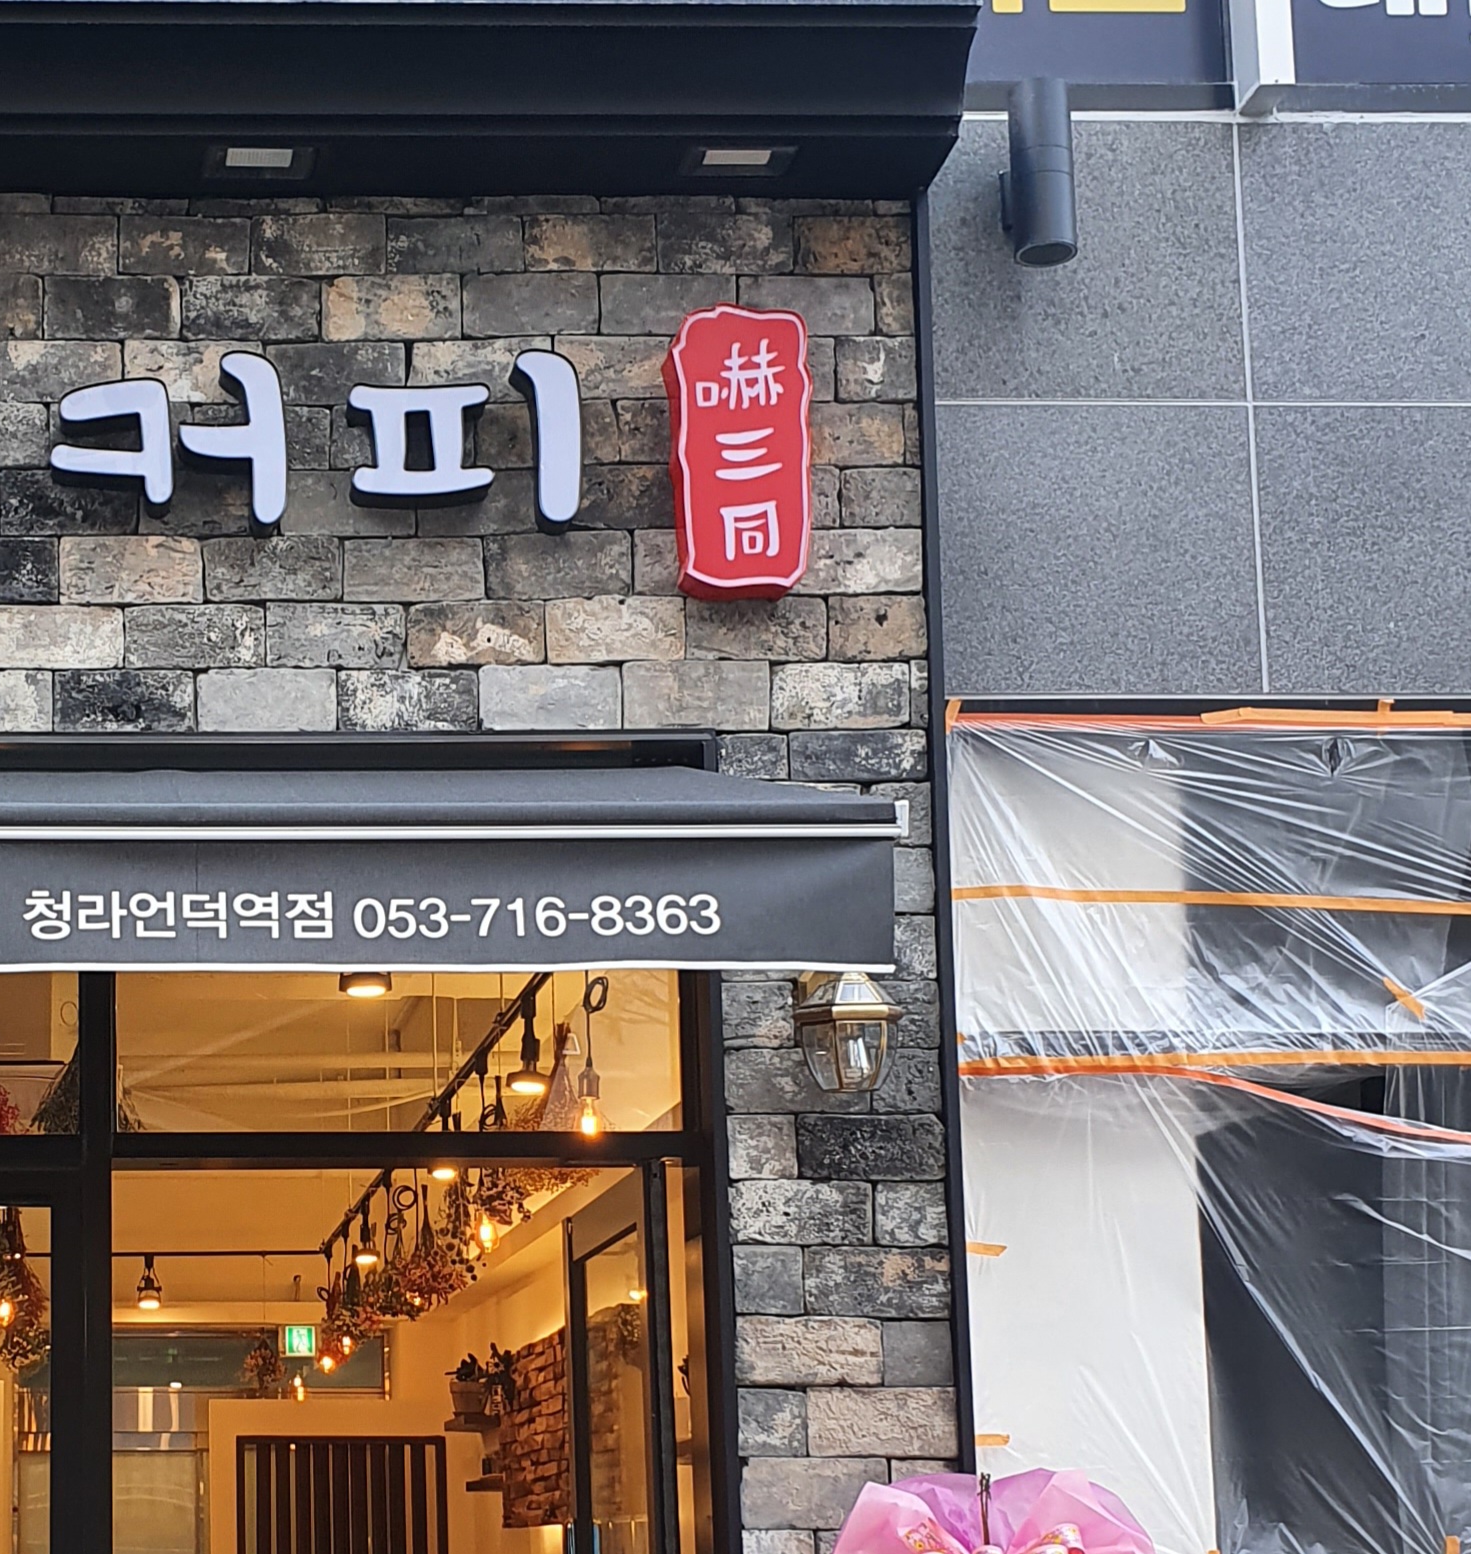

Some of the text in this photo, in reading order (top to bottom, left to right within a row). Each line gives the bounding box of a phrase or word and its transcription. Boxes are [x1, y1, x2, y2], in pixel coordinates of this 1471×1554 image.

[51, 348, 581, 525] 커피
[22, 890, 722, 941] 청라언덕역점 053-716-8363
